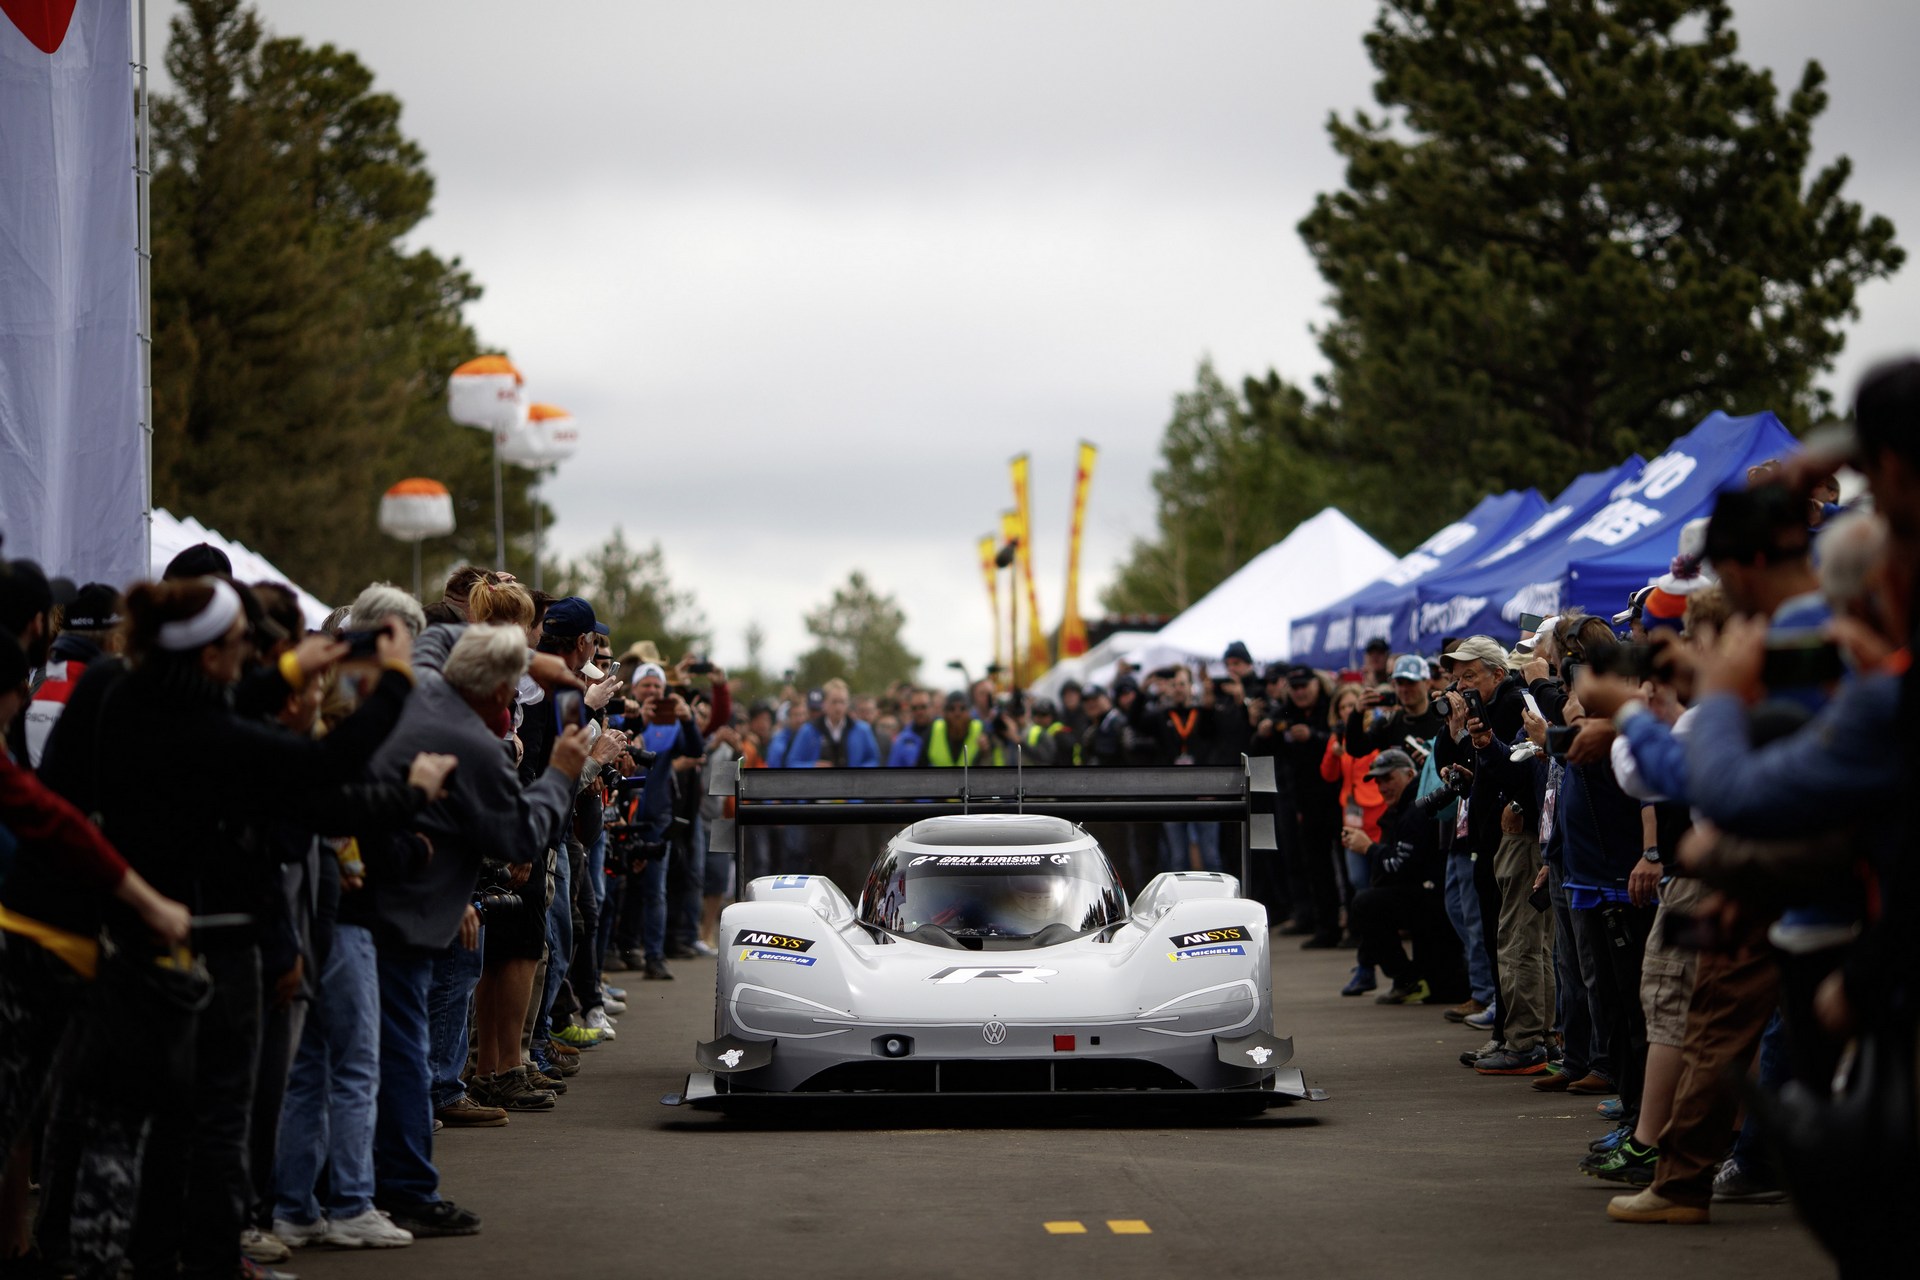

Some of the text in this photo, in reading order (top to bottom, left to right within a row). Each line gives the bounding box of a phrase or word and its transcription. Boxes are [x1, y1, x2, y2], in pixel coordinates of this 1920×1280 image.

[981, 855, 1041, 863] TURISMO
[741, 932, 801, 949] ANSYS
[1183, 928, 1241, 945] ANSYS
[761, 953, 810, 964] MICHELIN
[1191, 947, 1238, 957] MICHELIN
[921, 965, 1060, 985] R
